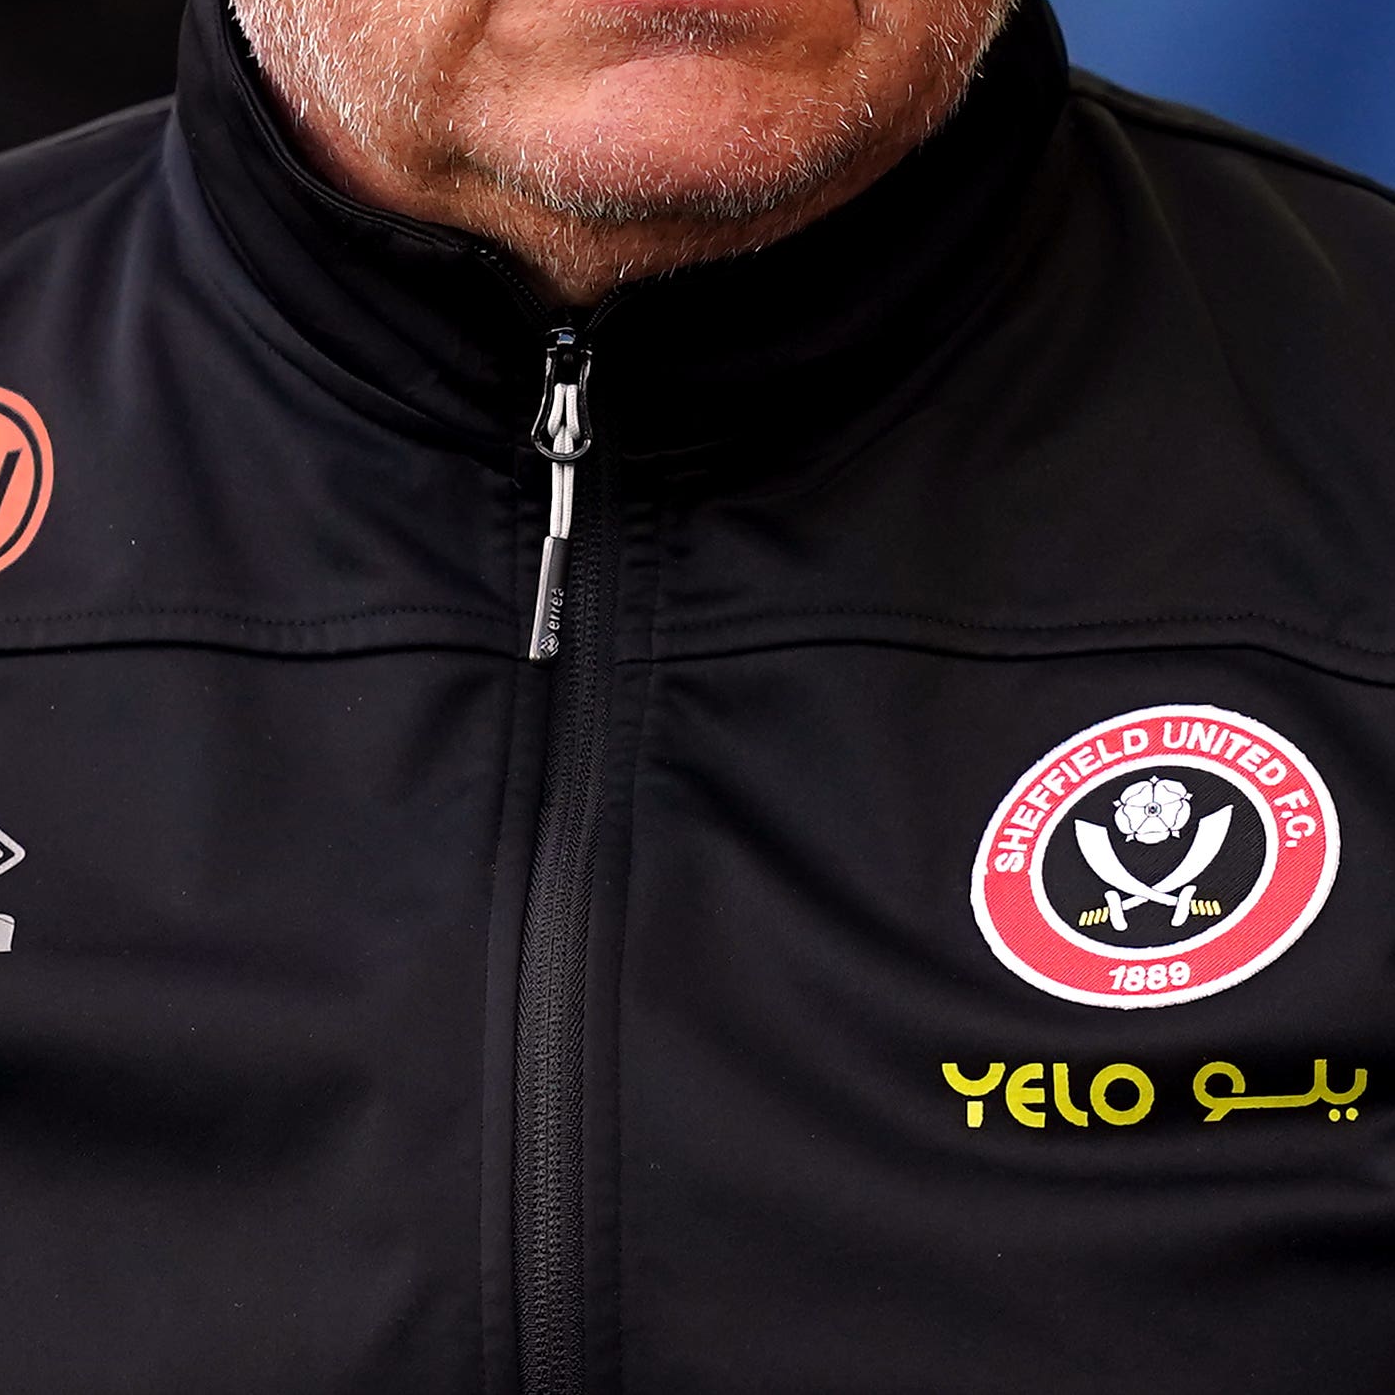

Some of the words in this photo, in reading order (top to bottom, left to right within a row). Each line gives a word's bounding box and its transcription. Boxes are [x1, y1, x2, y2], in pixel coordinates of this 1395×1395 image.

[994, 727, 1150, 873] SHEFFIELD
[1162, 721, 1288, 787] UNITED
[1273, 788, 1318, 849] F.C.
[1108, 960, 1192, 992] 1889
[941, 1062, 1156, 1129] YELO
